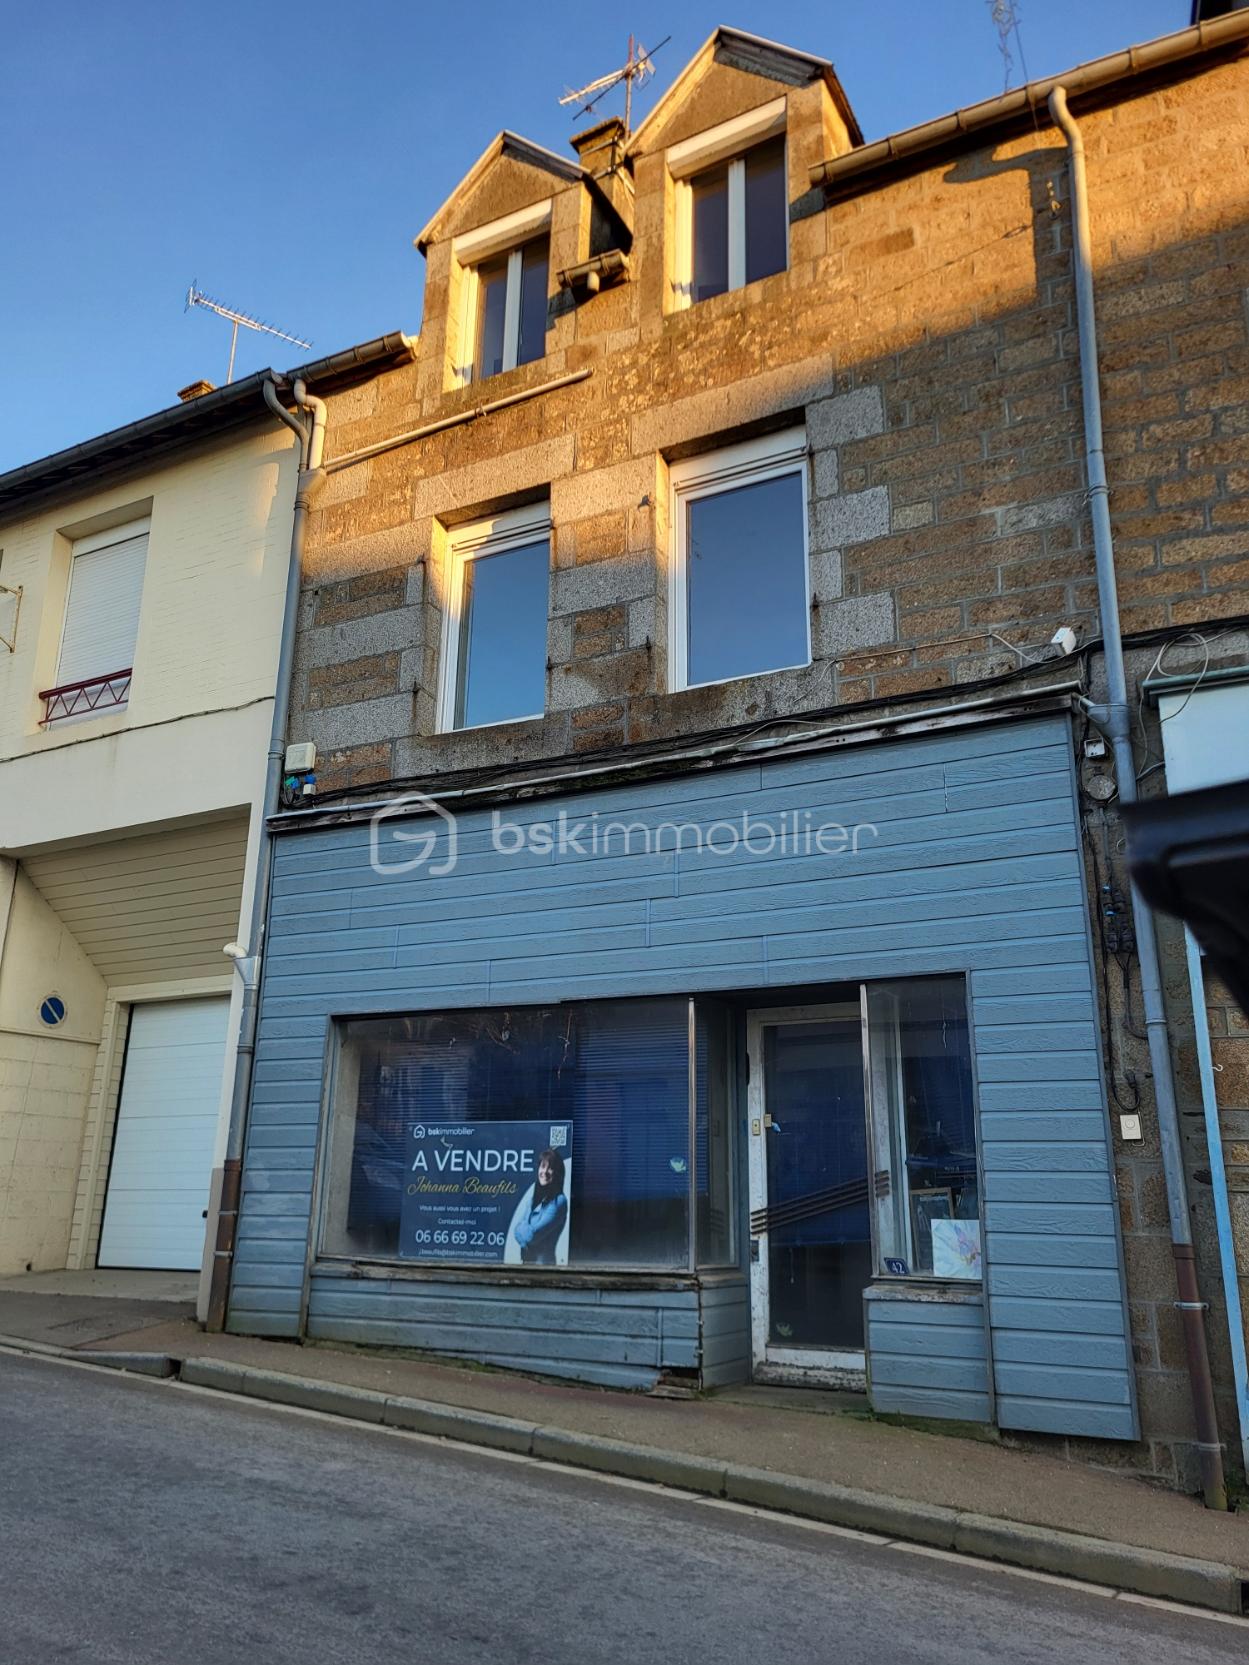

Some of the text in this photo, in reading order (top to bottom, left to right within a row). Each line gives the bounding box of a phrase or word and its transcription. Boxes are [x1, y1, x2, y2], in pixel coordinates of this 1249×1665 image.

[428, 1127, 474, 1135] bskimmobilier
[412, 1150, 534, 1171] A VENDRE
[408, 1175, 461, 1194] Johanna
[415, 1229, 505, 1246] 06 66 69 22 06
